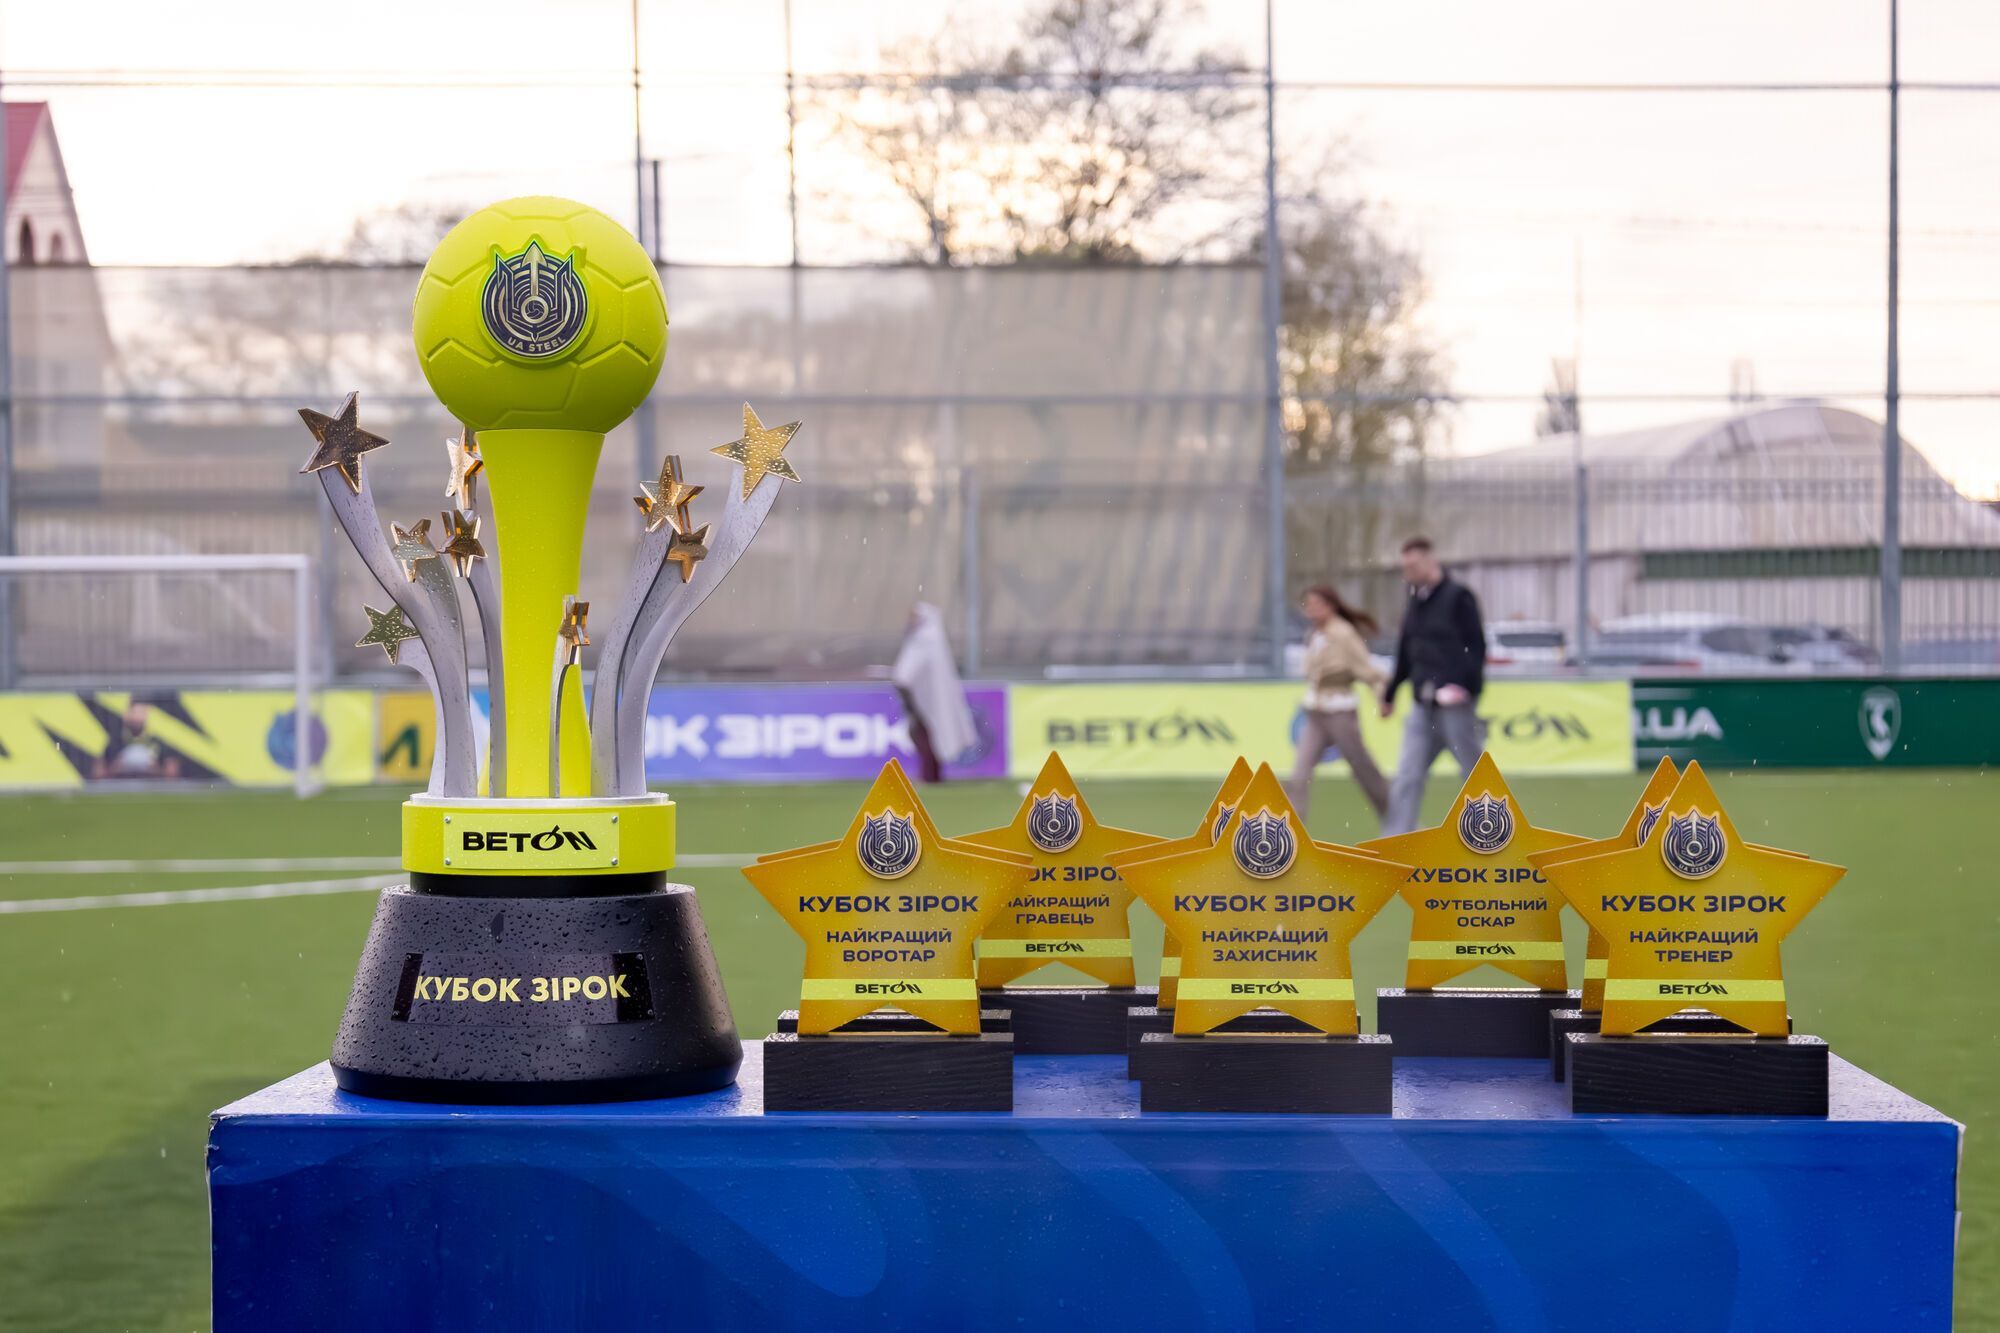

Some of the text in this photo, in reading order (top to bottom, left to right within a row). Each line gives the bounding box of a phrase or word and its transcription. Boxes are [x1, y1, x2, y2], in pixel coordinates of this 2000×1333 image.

[507, 336, 567, 352] UA STEEL
[1063, 866, 1123, 882] ЗІРО
[800, 896, 978, 912] КУБОК ЗІРОК
[1008, 895, 1110, 909] АЙКРАЩИЙ
[1174, 895, 1355, 912] КУБОК ЗІРОК
[1425, 898, 1547, 911] ФУТБОЛЬНИЙ
[1601, 895, 1786, 912] КУБОК ЗІРОК
[1016, 913, 1094, 926] ГРАВЕЦЬ
[1457, 916, 1515, 927] ОСКАР
[826, 930, 952, 945] НАЙКРАЩИЙ
[1202, 930, 1328, 945] НАЙКРАЩИЙ
[1630, 930, 1758, 945] НАЙКРАЩИЙ
[843, 950, 936, 963] ВОРОТАР
[1213, 949, 1318, 962] ЗАХИСНИК
[1655, 950, 1733, 963] ТРЕНЕР
[414, 974, 631, 1002] КУБОК ЗІРОК
